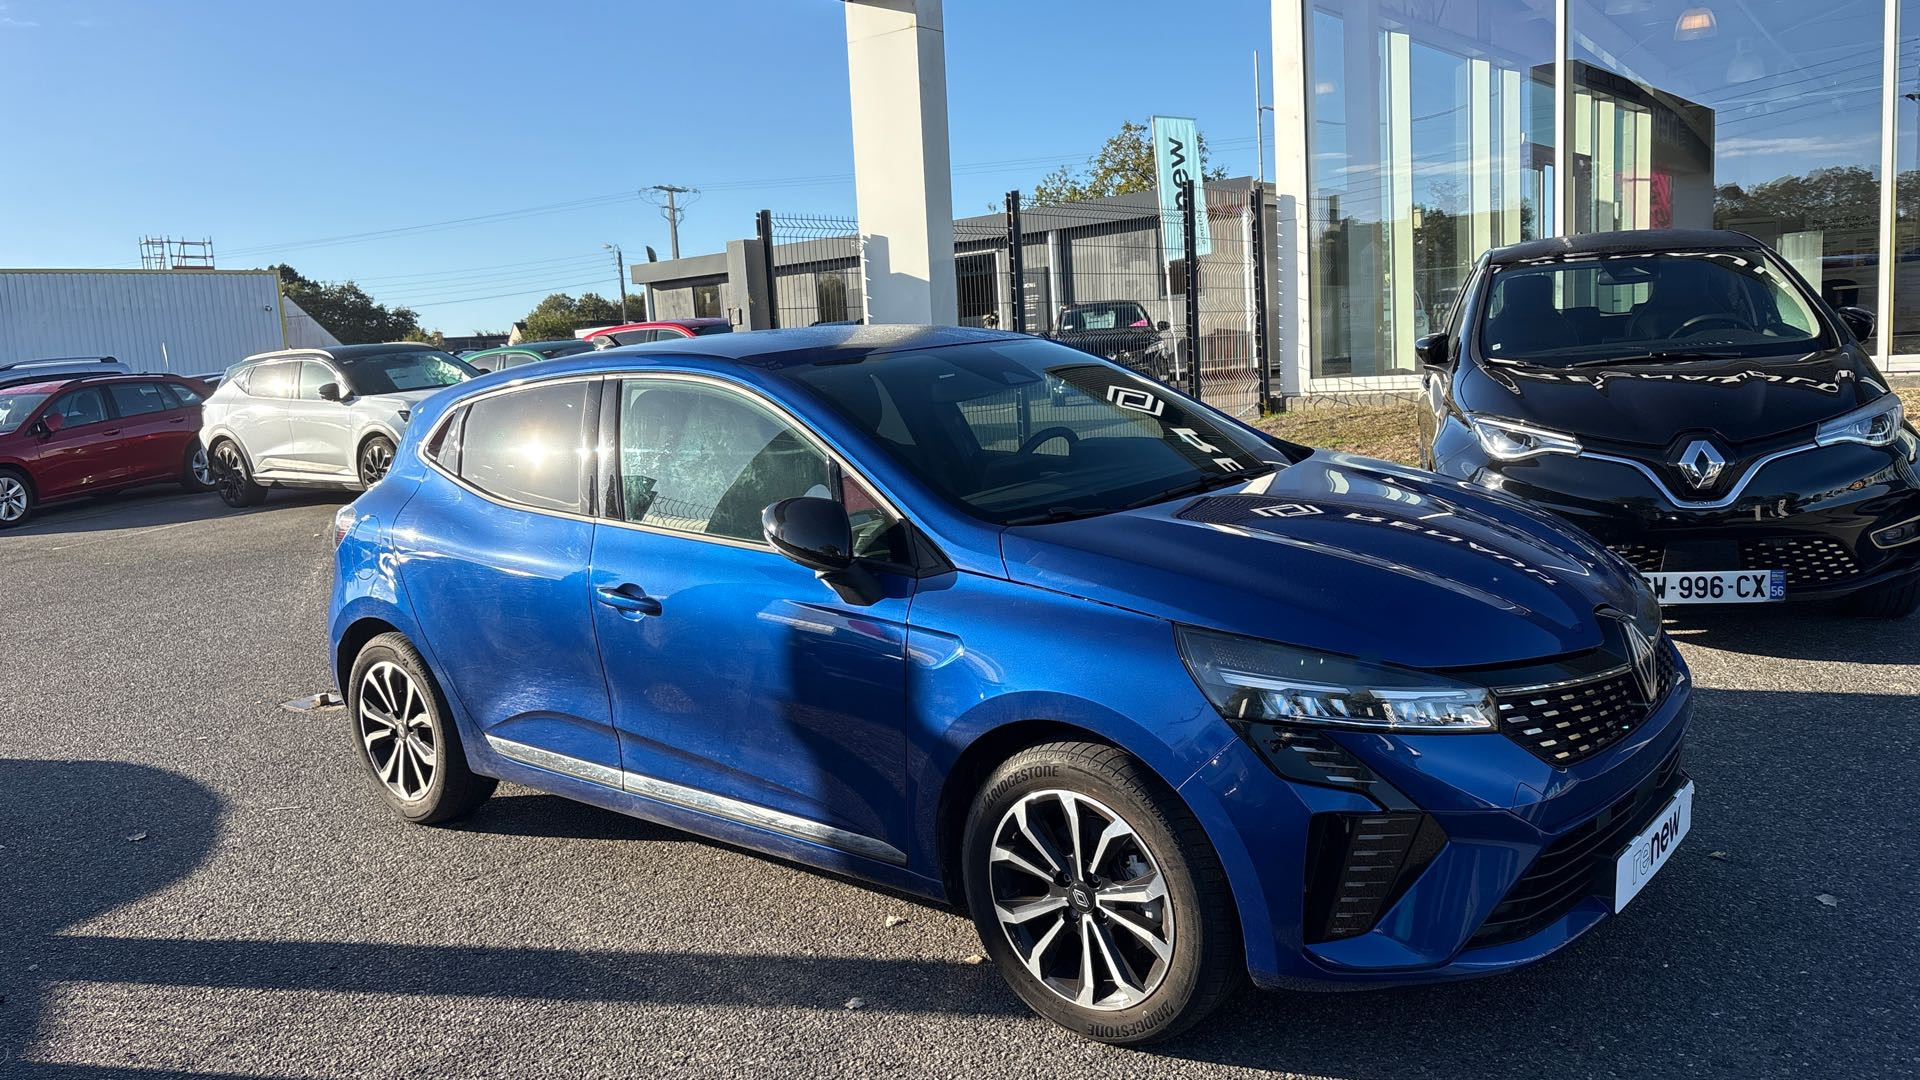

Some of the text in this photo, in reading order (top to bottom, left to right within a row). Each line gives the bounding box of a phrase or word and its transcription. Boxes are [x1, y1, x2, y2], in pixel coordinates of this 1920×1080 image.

[1771, 585, 1784, 597] 56
[983, 765, 1060, 809] BRIDGESTONE
[1631, 805, 1682, 886] renew
[1087, 999, 1175, 1038] BRIDGESTONE
